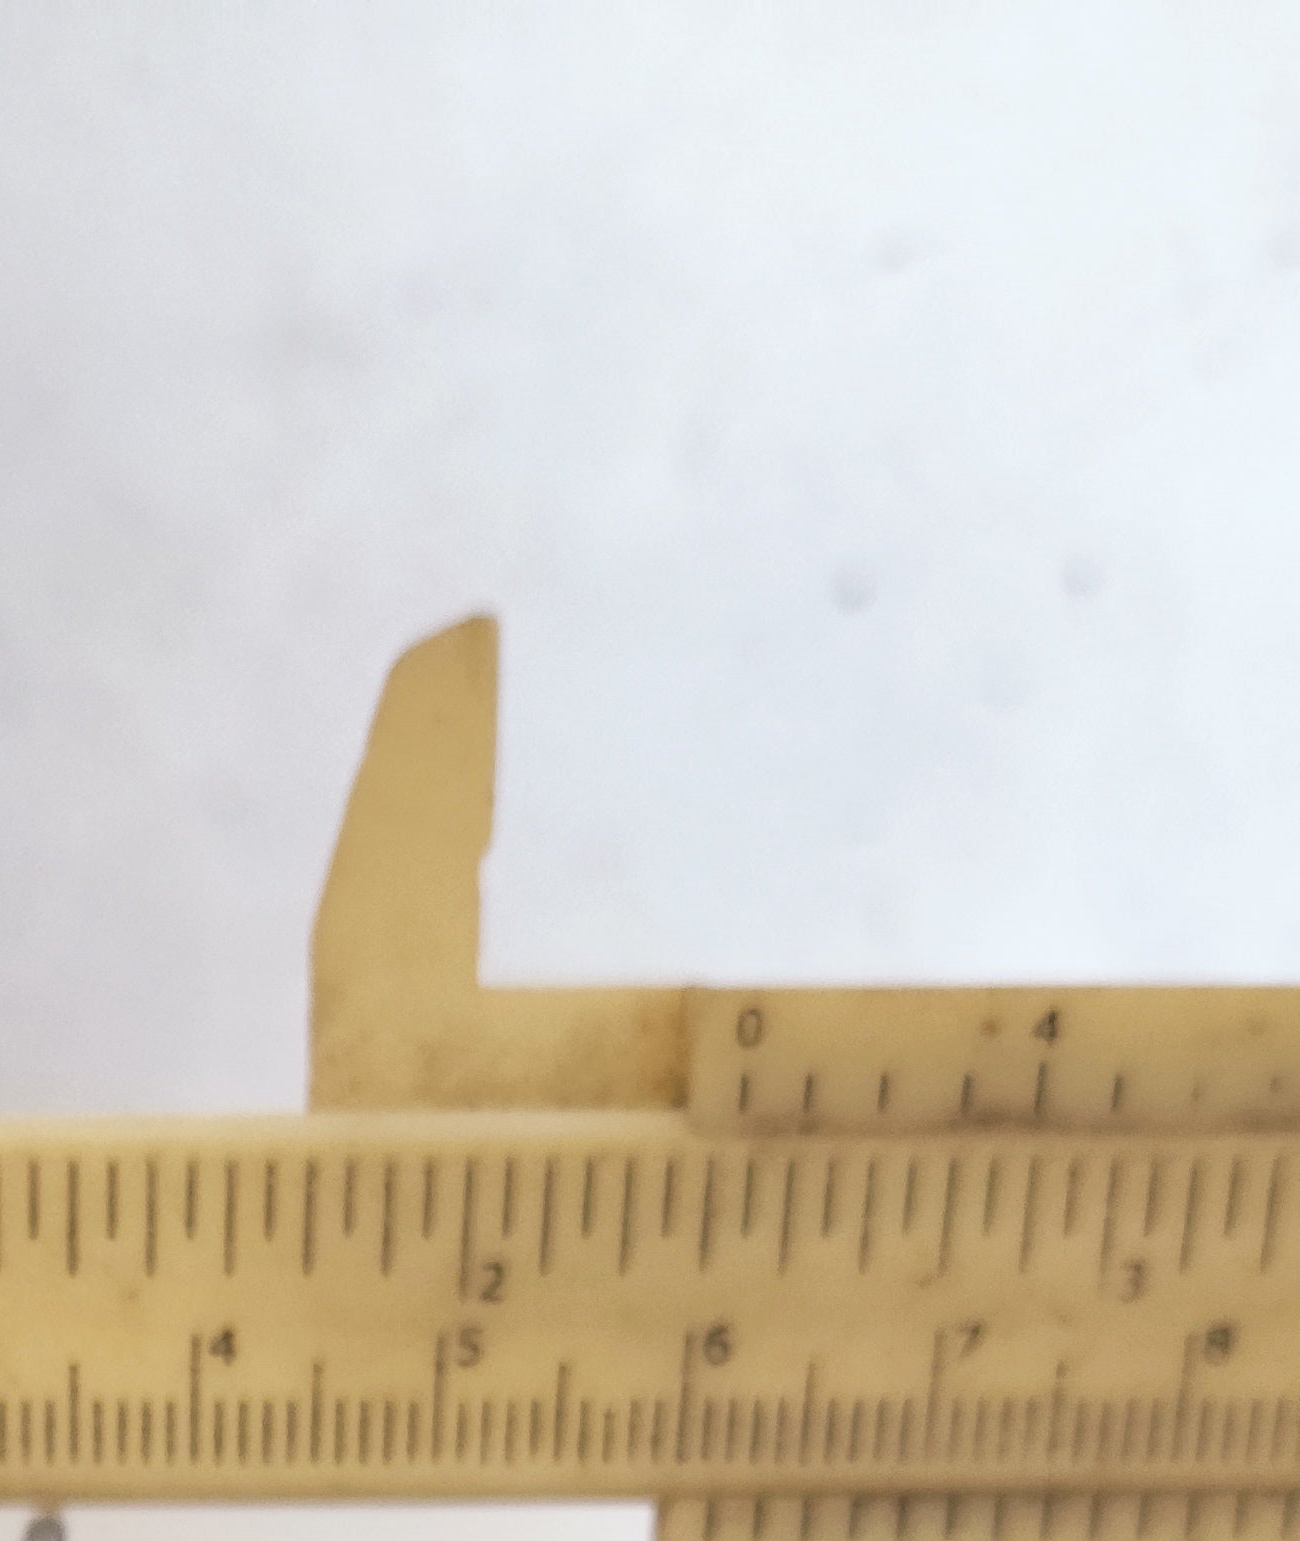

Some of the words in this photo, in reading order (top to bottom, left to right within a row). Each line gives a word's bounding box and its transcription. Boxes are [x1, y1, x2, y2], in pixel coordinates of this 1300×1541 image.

[737, 1006, 765, 1050] 0
[480, 1261, 506, 1303] 2
[1122, 1257, 1148, 1303] 3
[209, 1325, 237, 1366] 4
[456, 1325, 484, 1367] 5
[703, 1321, 733, 1367] 6
[955, 1320, 986, 1358] 7
